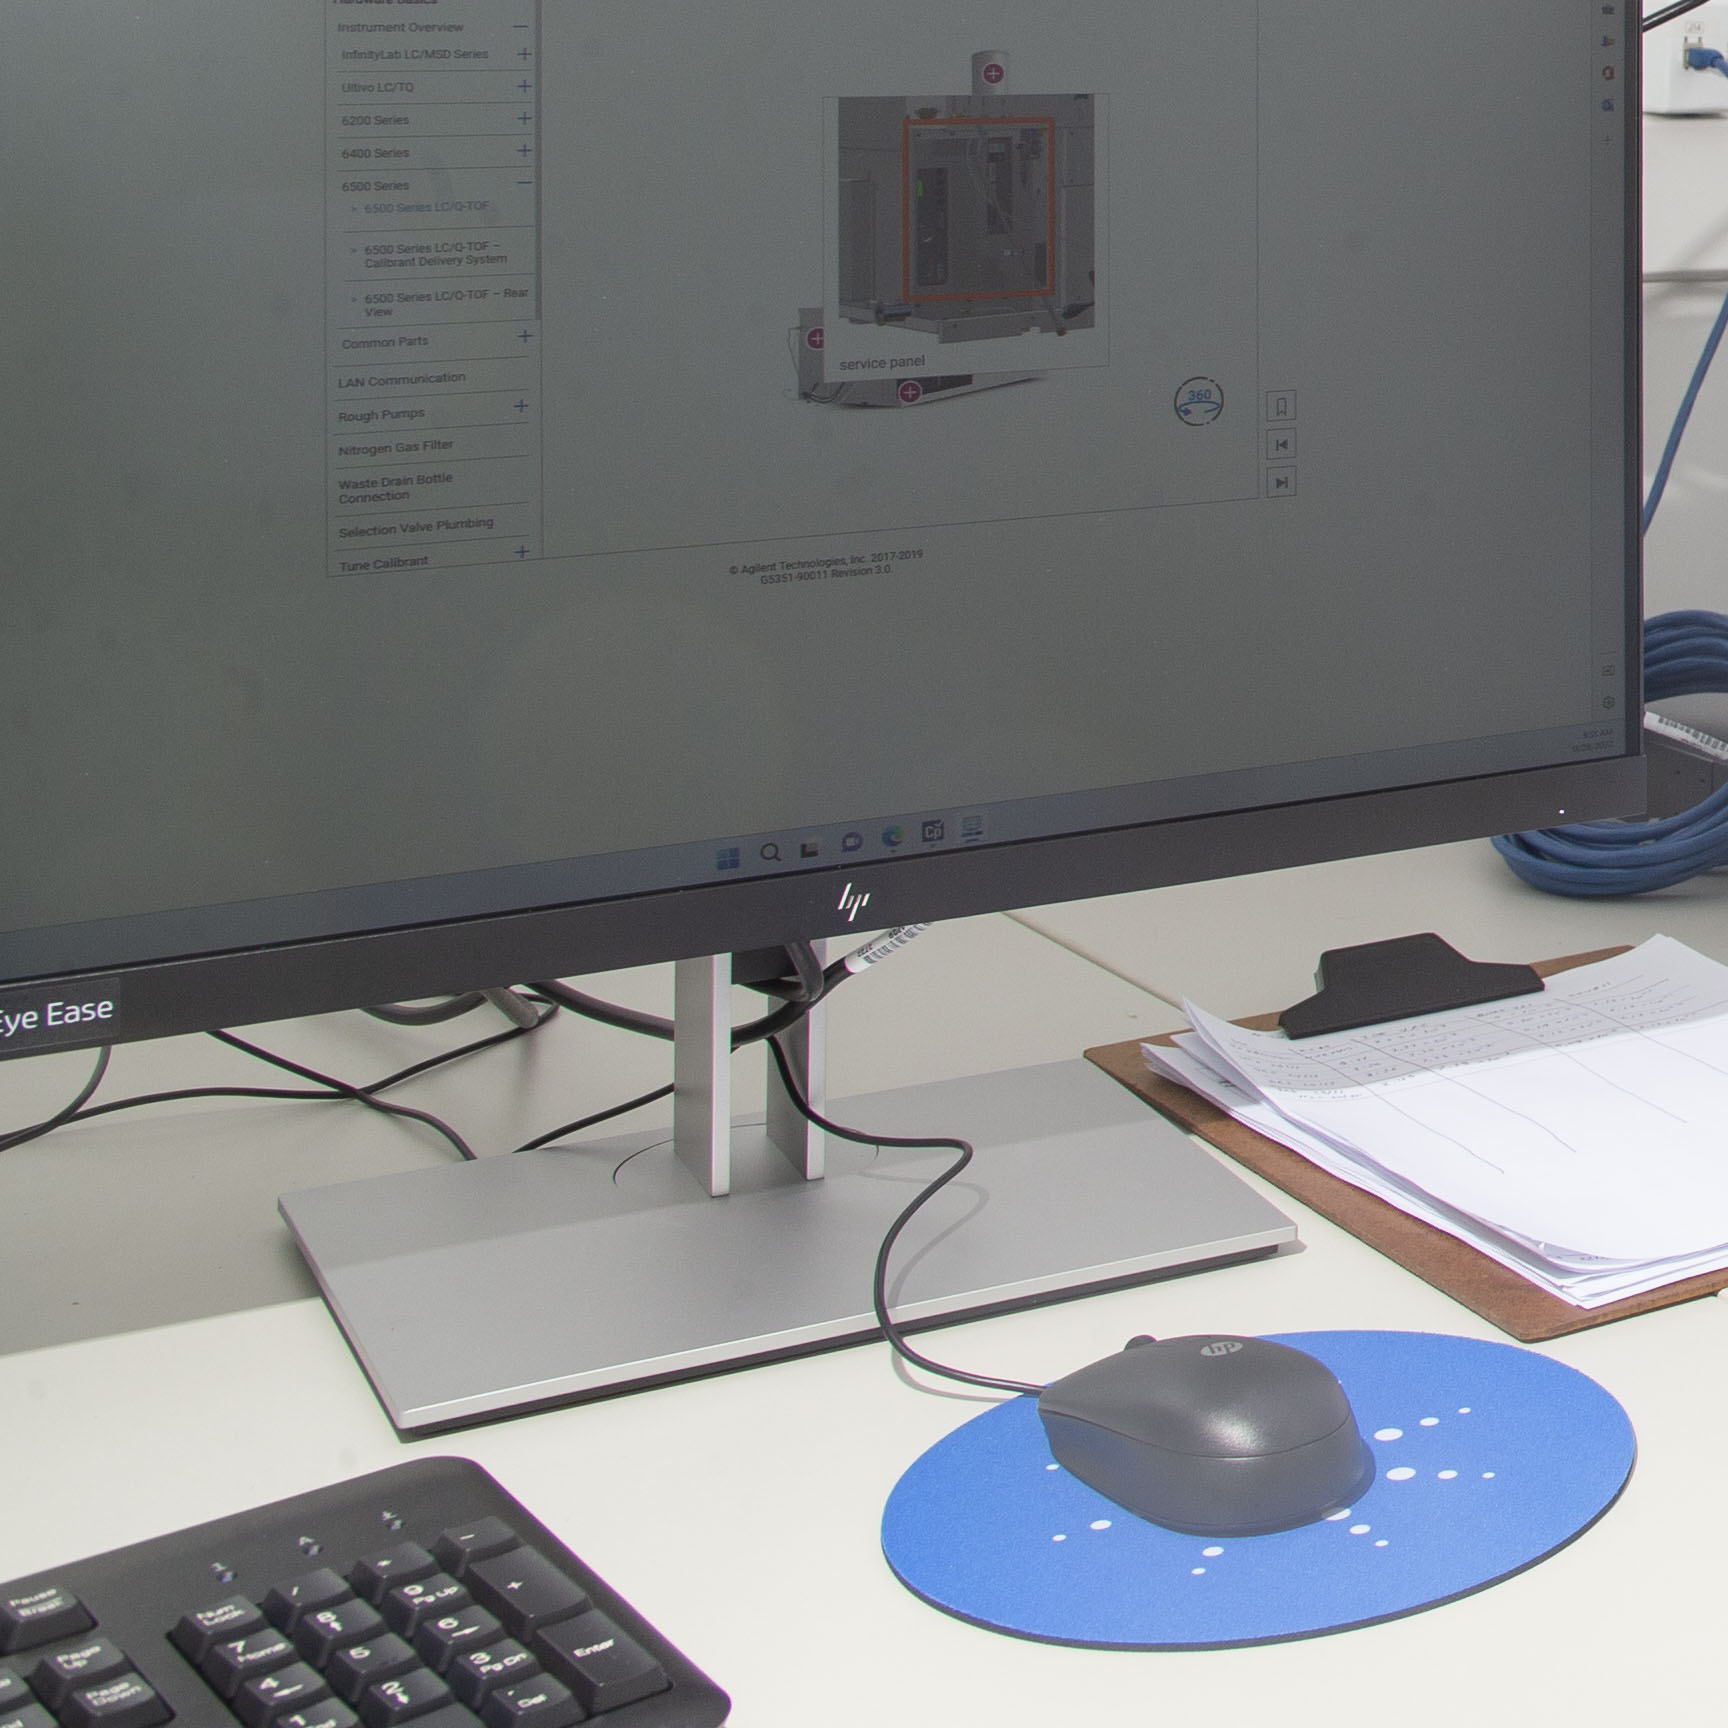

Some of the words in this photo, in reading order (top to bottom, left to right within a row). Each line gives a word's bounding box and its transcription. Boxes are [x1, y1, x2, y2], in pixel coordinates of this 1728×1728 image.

[338, 22, 406, 33] Instrument
[408, 22, 464, 33] Overview
[342, 49, 401, 61] InfinityLab
[404, 49, 451, 60] LC/MSD
[453, 49, 489, 60] Series
[342, 82, 375, 94] Ultivo
[342, 115, 371, 126] 6200
[374, 114, 410, 126] Series
[342, 149, 371, 159] 6400
[374, 148, 410, 159] Series
[342, 182, 371, 192] 6500
[374, 181, 410, 192] Series
[364, 204, 394, 214] 6500
[396, 202, 432, 213] Series
[434, 200, 490, 212] LC/Q-TOF
[364, 244, 394, 255] 6500
[396, 243, 432, 254] Series
[434, 241, 490, 253] LC/Q-TOF
[364, 257, 417, 269] Calibrant
[418, 256, 463, 268] Delivery
[465, 254, 508, 266] System
[364, 293, 394, 304] 6500
[396, 292, 432, 303] Series
[434, 289, 489, 301] LC/Q-TOF
[503, 288, 529, 298] Rear
[364, 307, 393, 318] View
[342, 338, 396, 349] Common
[399, 336, 429, 347] Parts
[839, 357, 887, 371] service
[889, 355, 926, 370] panel
[338, 377, 365, 389] LAN
[367, 372, 466, 387] Communication
[1187, 388, 1212, 402] 360
[338, 409, 379, 423] Rough
[381, 407, 425, 421] Pumps
[338, 444, 393, 458] Nitrogen
[395, 442, 420, 453] Gas
[422, 439, 454, 451] Filter
[338, 478, 378, 490] Waste
[381, 476, 414, 487] Drain
[416, 473, 454, 485] Bottle
[338, 490, 410, 504] Connection
[338, 524, 397, 538] Selection
[399, 521, 433, 534] Valve
[436, 517, 494, 532] Plumbing
[339, 560, 370, 573] Tune
[372, 556, 429, 571] Calibrant
[741, 562, 777, 576] Agilent
[871, 549, 924, 562] 2017-2019
[831, 566, 873, 578] Revision
[836, 882, 871, 922] hp
[45, 1000, 114, 1026] Ease
[8, 1587, 58, 1608] Pause
[436, 1585, 459, 1598] Up
[18, 1595, 65, 1618] Break
[196, 1603, 236, 1620] Num
[202, 1609, 247, 1627] Lock
[56, 1645, 102, 1664] Page
[236, 1641, 287, 1662] Home
[348, 1646, 371, 1660] 5
[573, 1638, 615, 1658] Enter
[62, 1658, 88, 1671] Up
[469, 1651, 492, 1665] 3
[85, 1681, 131, 1702] Page
[258, 1677, 280, 1691] 4
[92, 1684, 142, 1707] Down
[517, 1692, 548, 1709] Del
